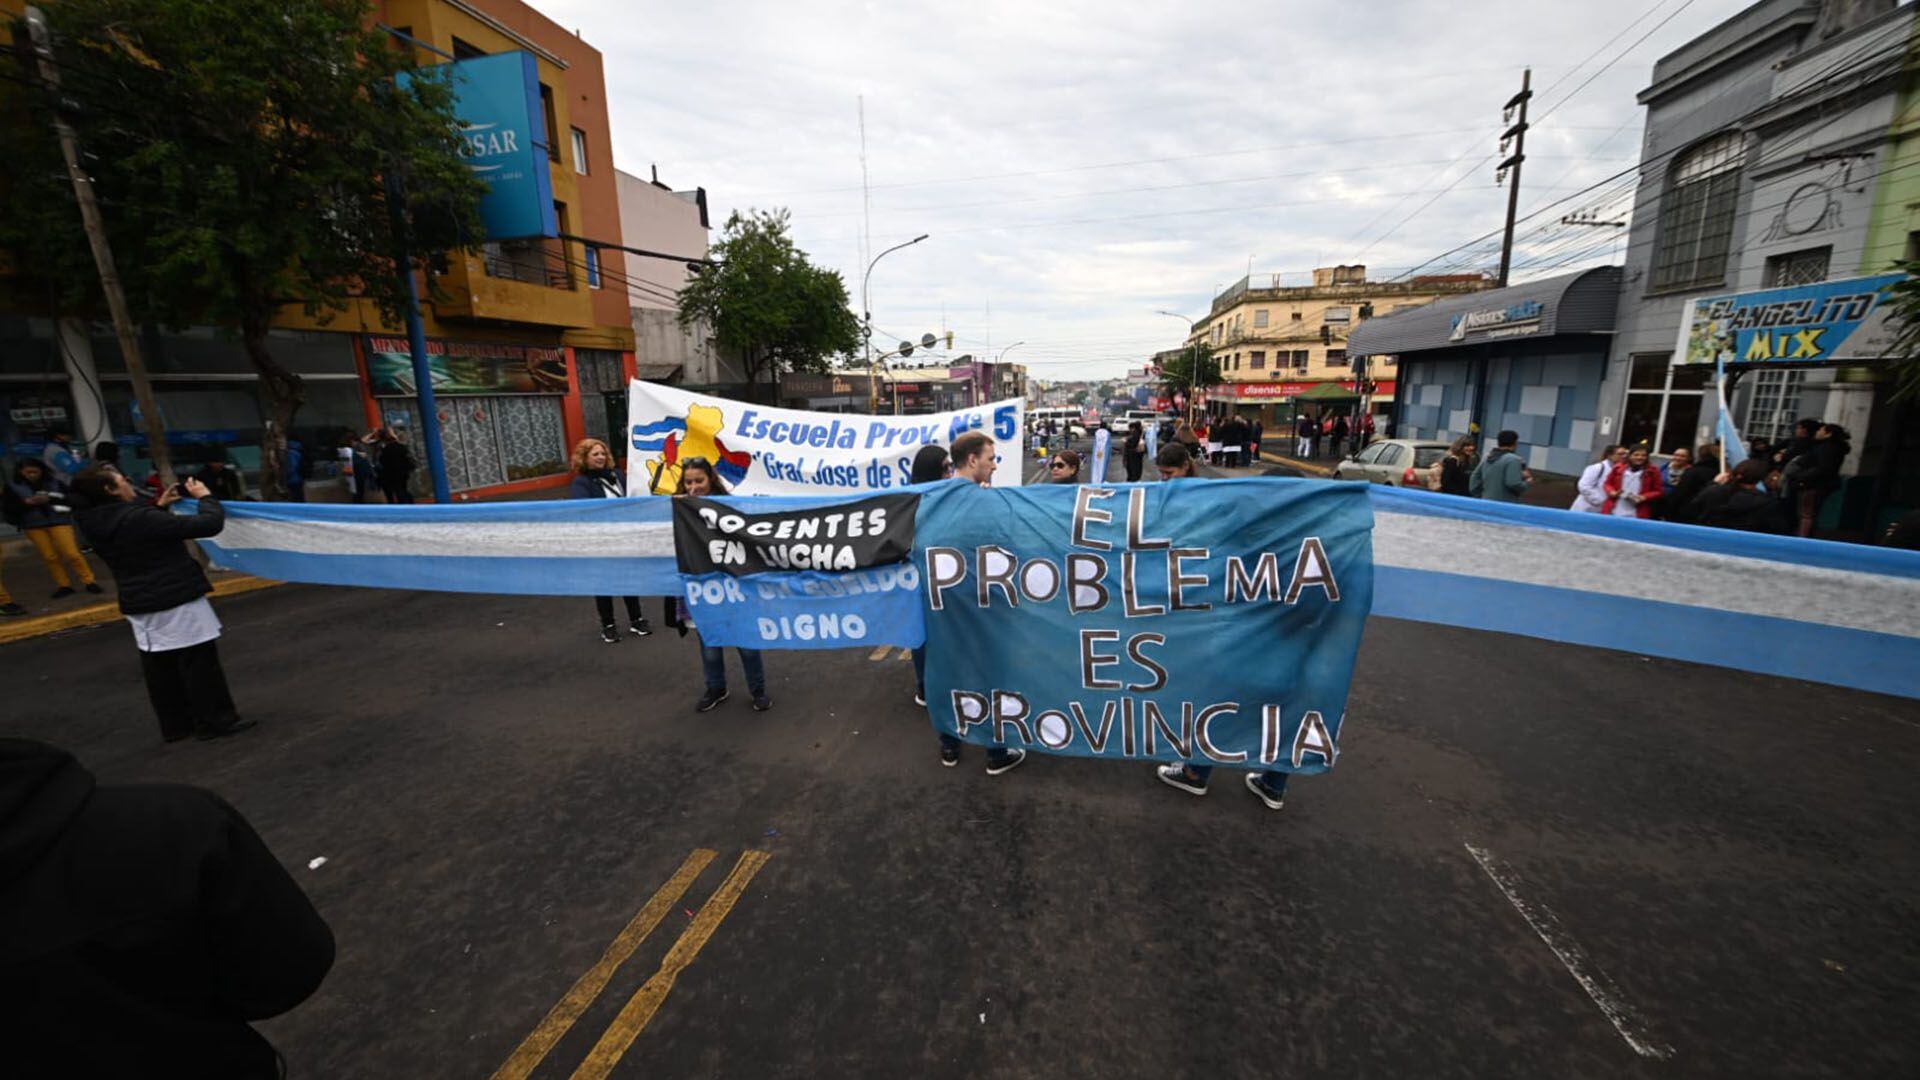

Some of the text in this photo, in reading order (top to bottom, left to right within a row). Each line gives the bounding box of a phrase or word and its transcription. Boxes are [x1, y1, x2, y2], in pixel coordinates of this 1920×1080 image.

[736, 409, 857, 450] Escuela
[864, 421, 940, 449] Prov.
[993, 406, 1017, 441] 5
[811, 457, 859, 488] José
[866, 461, 891, 488] de
[698, 507, 887, 540] DOCENTES
[1071, 484, 1171, 552] EL
[708, 540, 857, 571] EN LUCHA
[686, 578, 746, 606] POR
[925, 536, 1341, 618] PROBLEMA
[757, 613, 868, 641] DIGNO
[1080, 628, 1168, 692] ES
[952, 689, 1339, 770] PROVINCIA
